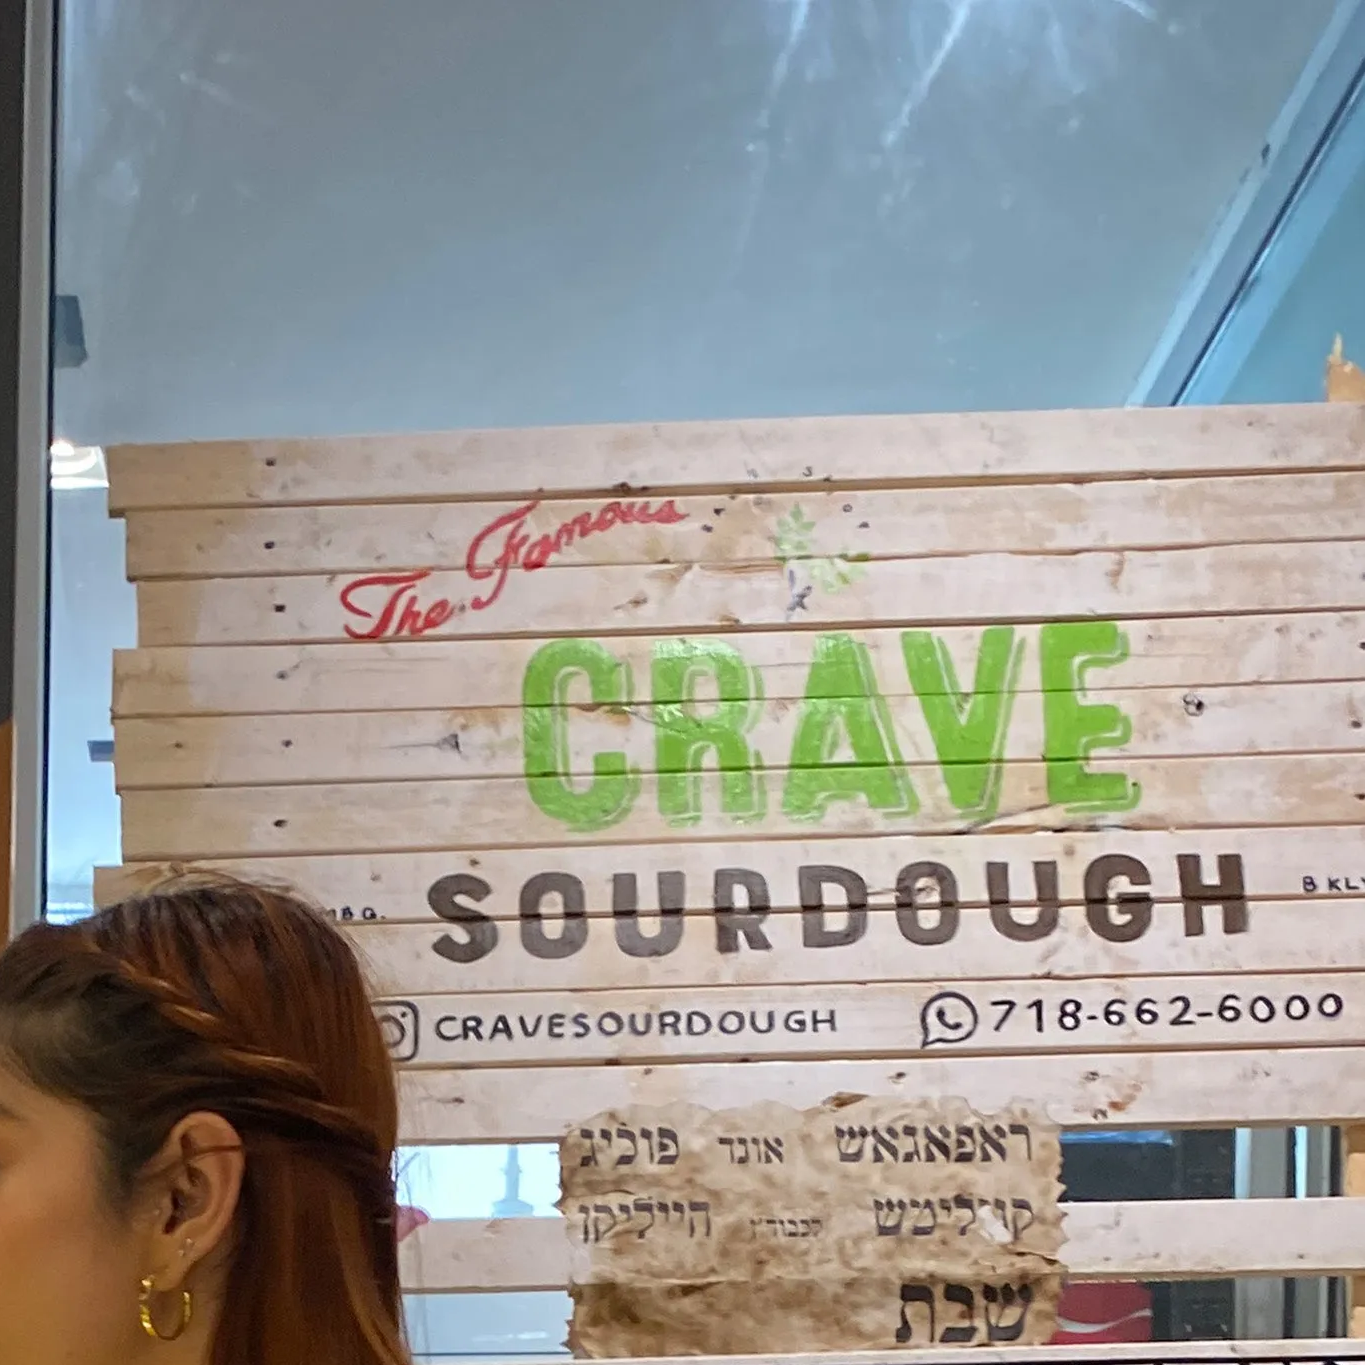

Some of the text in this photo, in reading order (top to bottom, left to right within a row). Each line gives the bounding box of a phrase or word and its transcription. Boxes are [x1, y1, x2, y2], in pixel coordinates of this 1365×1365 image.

[340, 500, 689, 639] The Famous
[522, 621, 1142, 832] CRAVE
[427, 852, 1250, 964] SOURDOUGH
[435, 1008, 837, 1042] CRAVESOURDOUGH
[990, 992, 1344, 1034] 718-662-6000
[895, 1282, 1032, 1343] שבת
